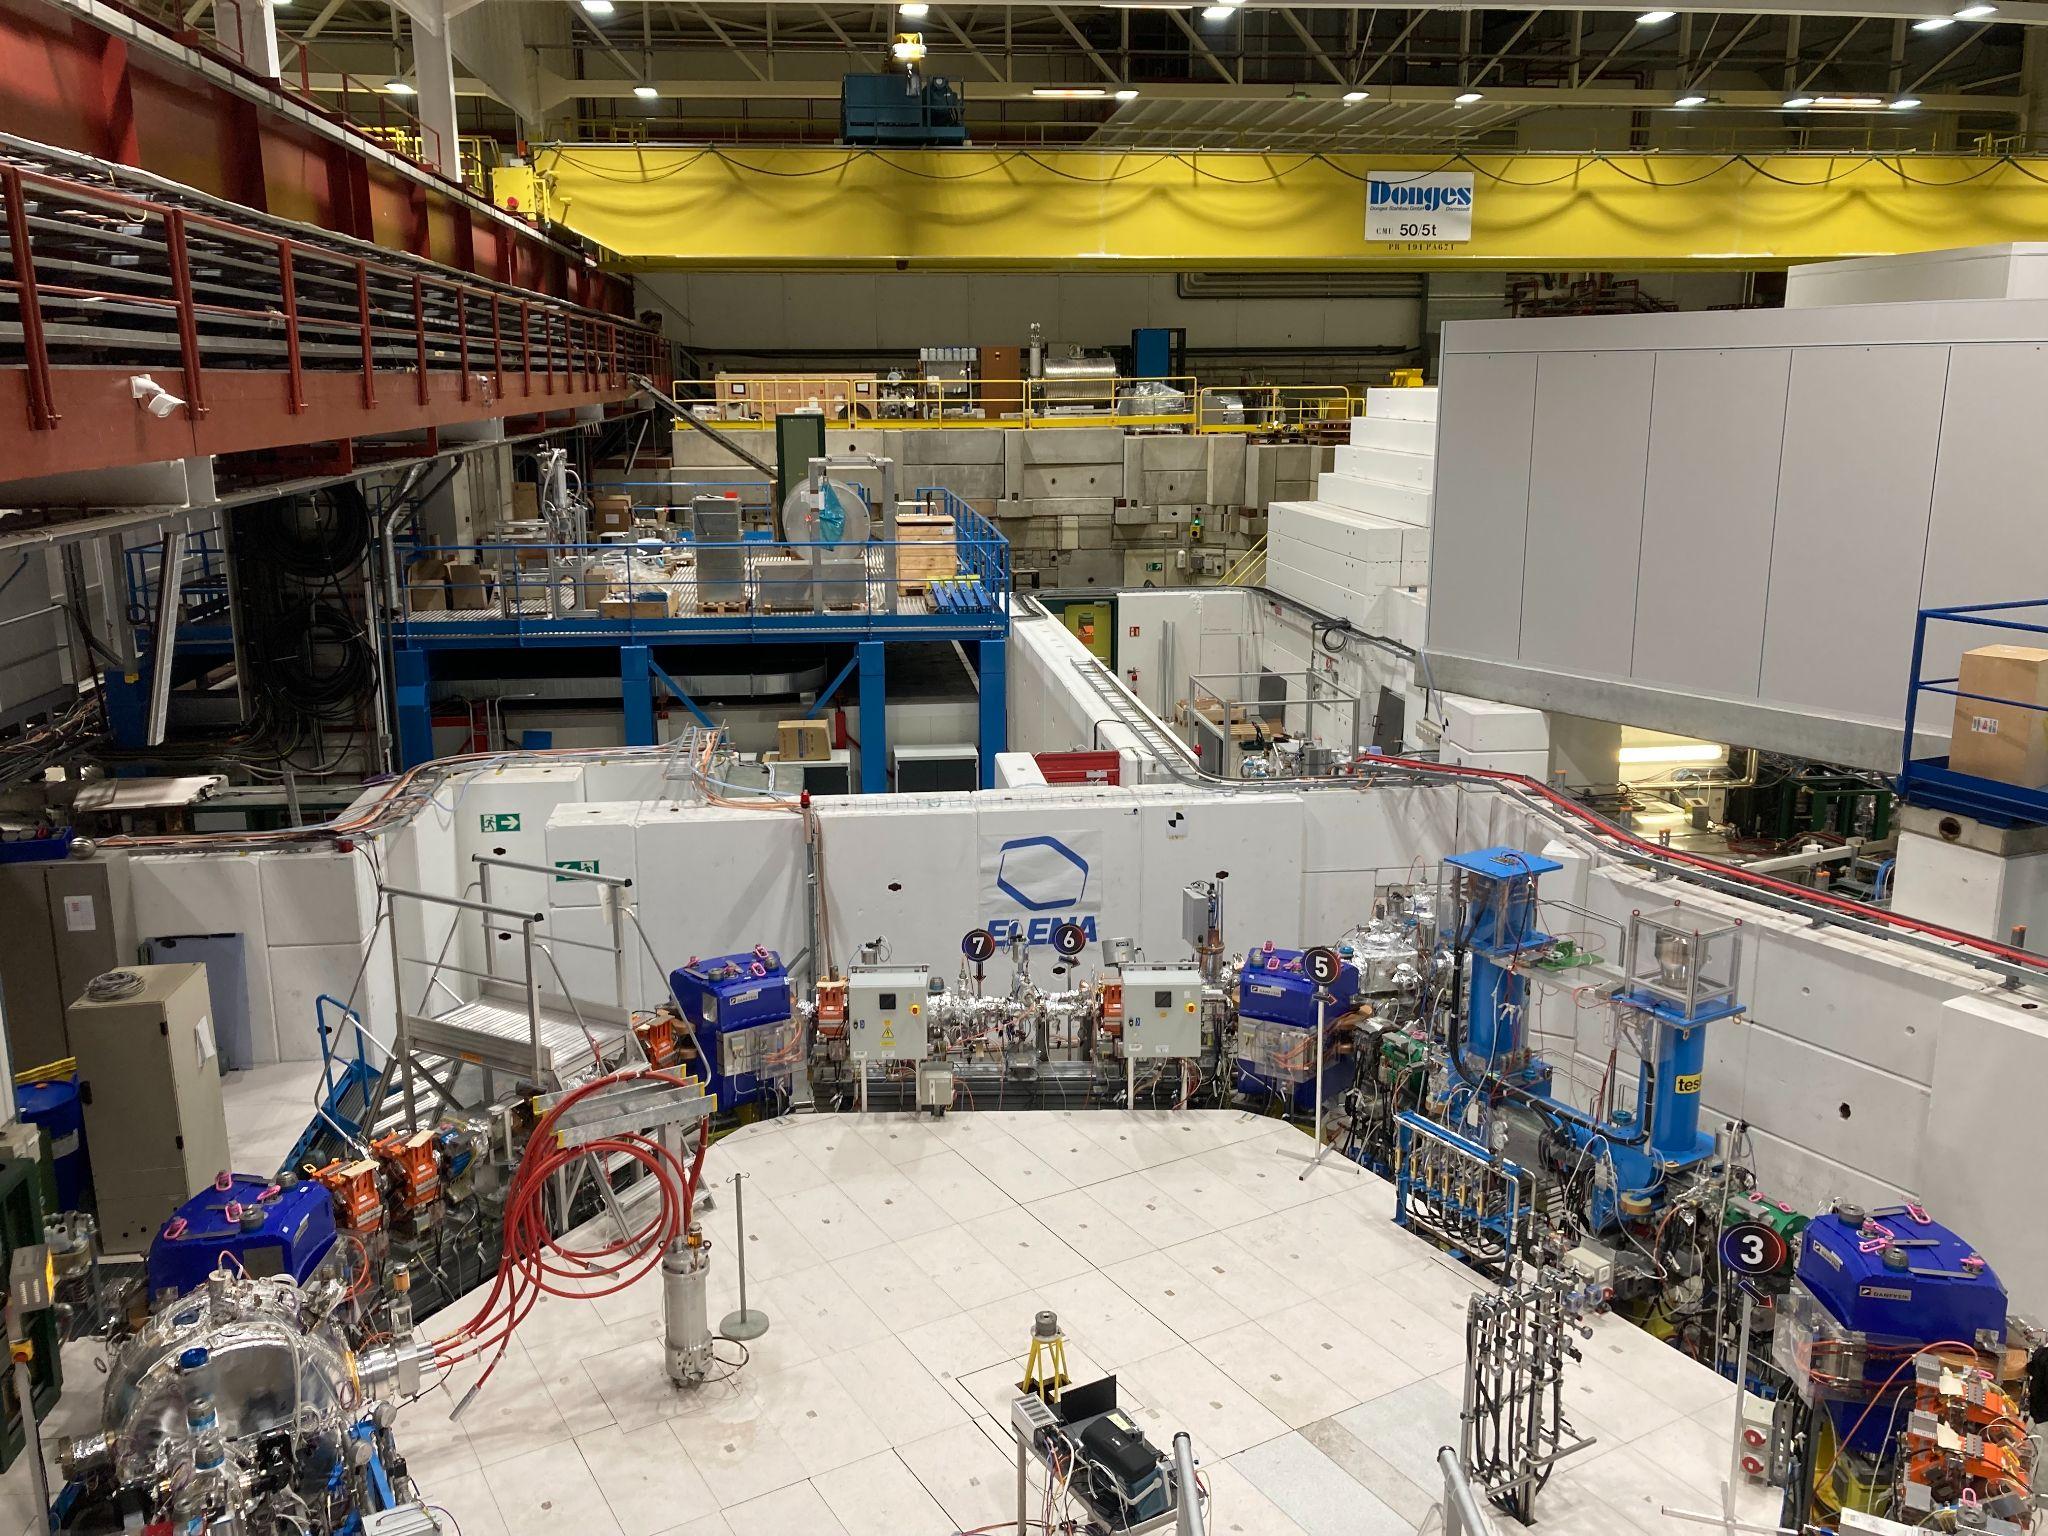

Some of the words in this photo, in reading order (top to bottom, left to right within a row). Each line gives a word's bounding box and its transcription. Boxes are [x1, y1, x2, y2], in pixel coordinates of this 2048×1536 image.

[1370, 181, 1471, 211] Donges
[972, 936, 985, 955] 7
[1063, 930, 1075, 948] 6
[1315, 955, 1328, 978] 5
[1678, 1076, 1702, 1091] tes
[1740, 1234, 1764, 1265] 3
